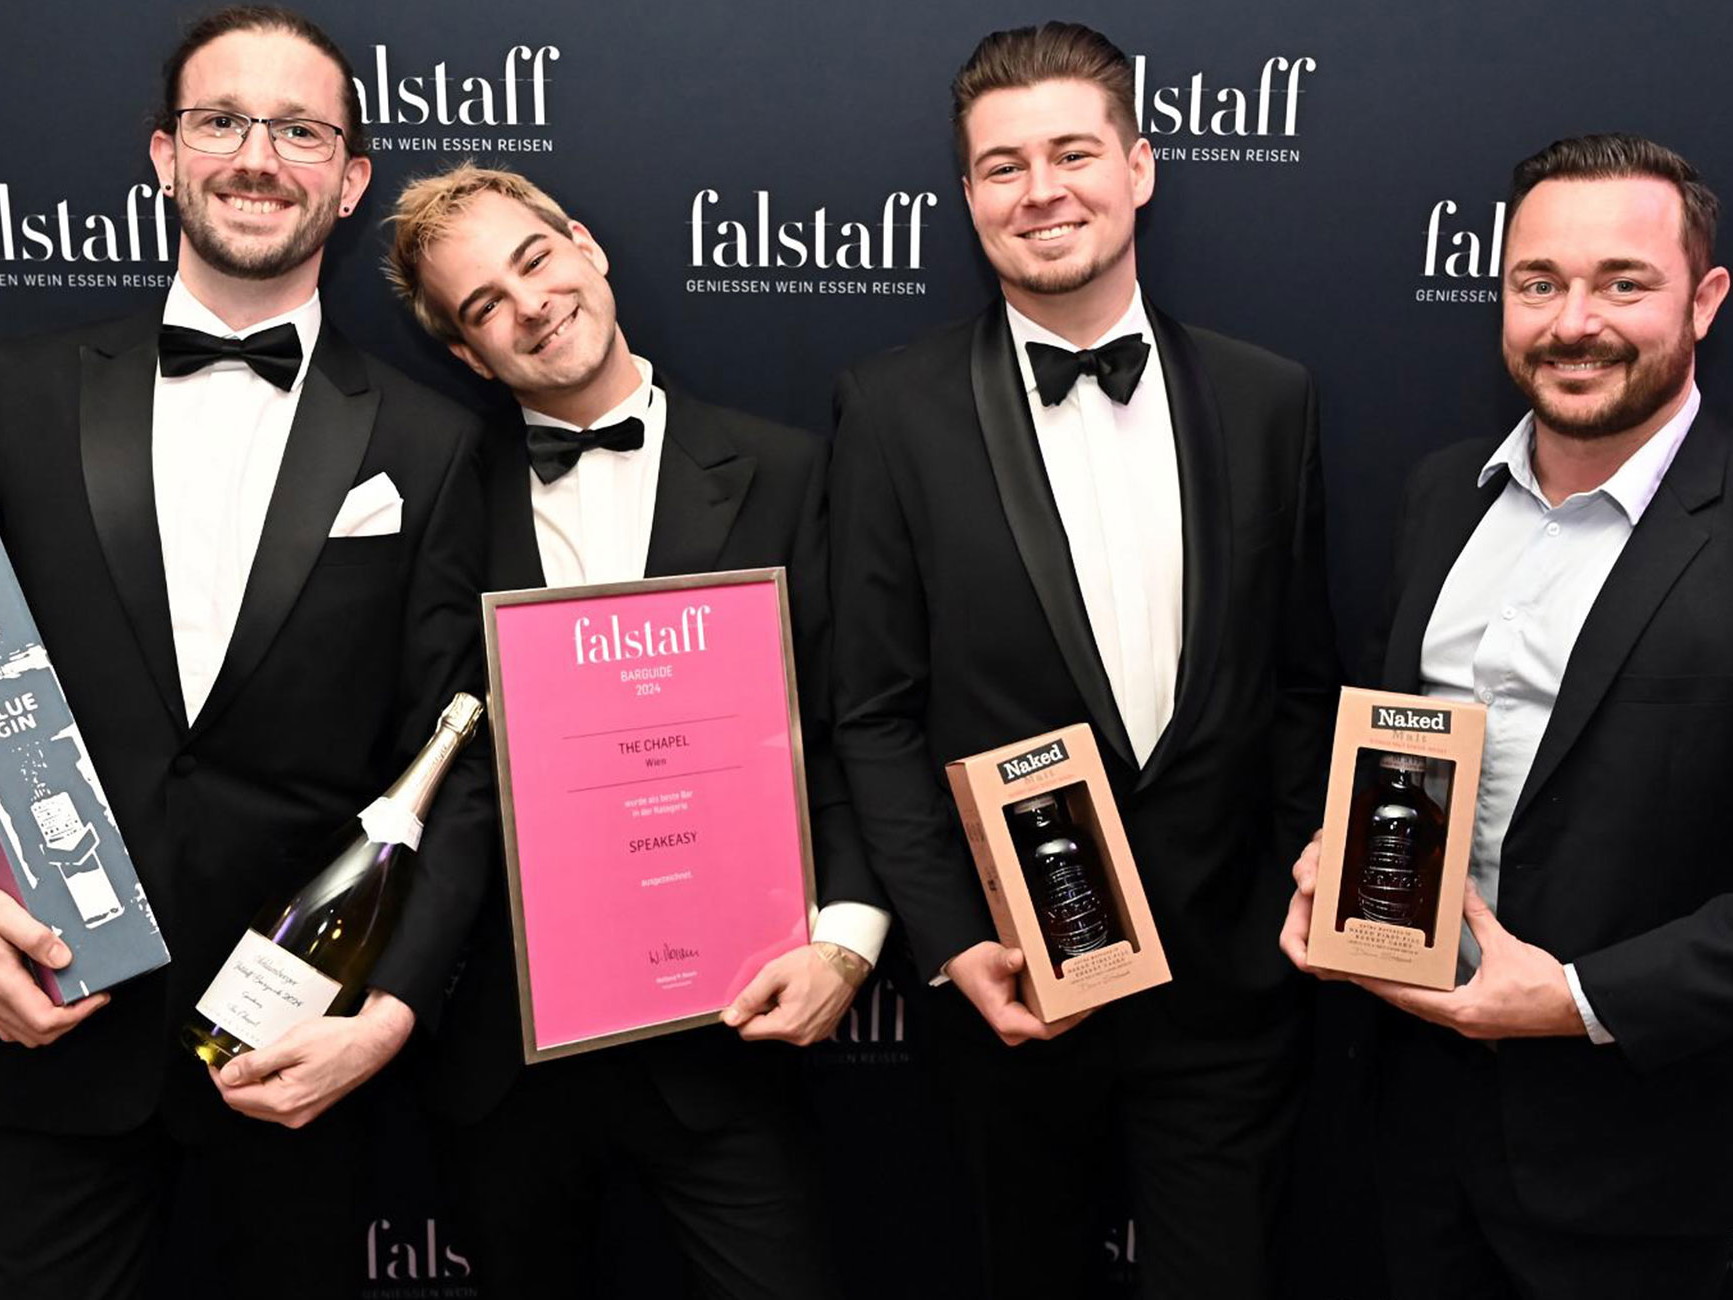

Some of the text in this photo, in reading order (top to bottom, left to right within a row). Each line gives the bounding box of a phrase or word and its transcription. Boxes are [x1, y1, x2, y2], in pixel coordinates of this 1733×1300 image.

[398, 138, 437, 150] WEIN
[443, 138, 492, 151] ESSEN
[498, 139, 553, 151] REISEN
[1192, 149, 1240, 161] ESSEN
[1246, 149, 1300, 162] REISEN
[686, 189, 938, 269] falstaff
[24, 274, 62, 287] WEIN
[69, 274, 117, 287] ESSEN
[686, 280, 926, 295] GENIESSEN WEIN ESSEN REISEN
[1416, 289, 1498, 302] GENIESSEN
[572, 605, 711, 665] falstaff
[621, 665, 673, 682] BARGUIDE
[636, 683, 661, 695] 2024
[1377, 708, 1445, 730] Naked
[618, 735, 690, 754] THE CHAPEL
[645, 758, 667, 767] Wien
[1003, 743, 1064, 780] Naked
[629, 832, 697, 853] SPEAKEASY
